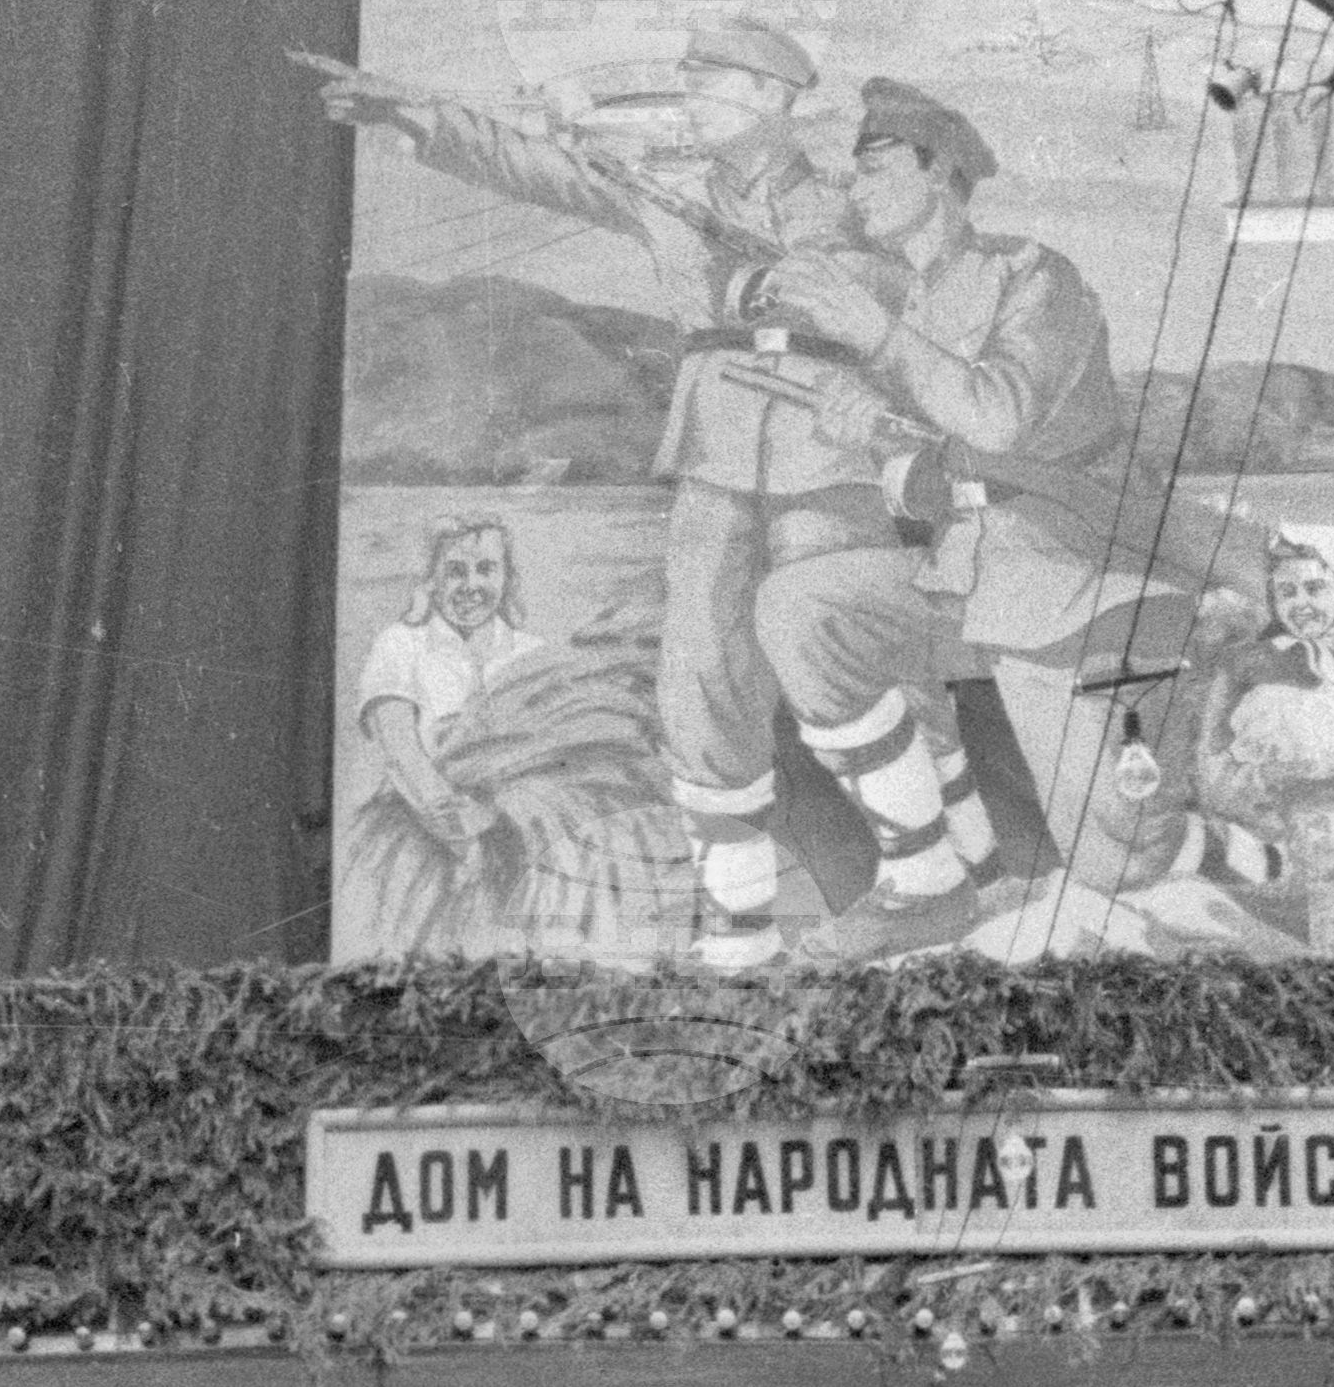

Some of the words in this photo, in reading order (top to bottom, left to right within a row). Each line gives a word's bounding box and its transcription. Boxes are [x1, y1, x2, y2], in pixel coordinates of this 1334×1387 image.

[361, 1147, 509, 1235] ДОМ
[558, 1144, 645, 1220] НА
[686, 1134, 1097, 1221] НАРОДНАТА
